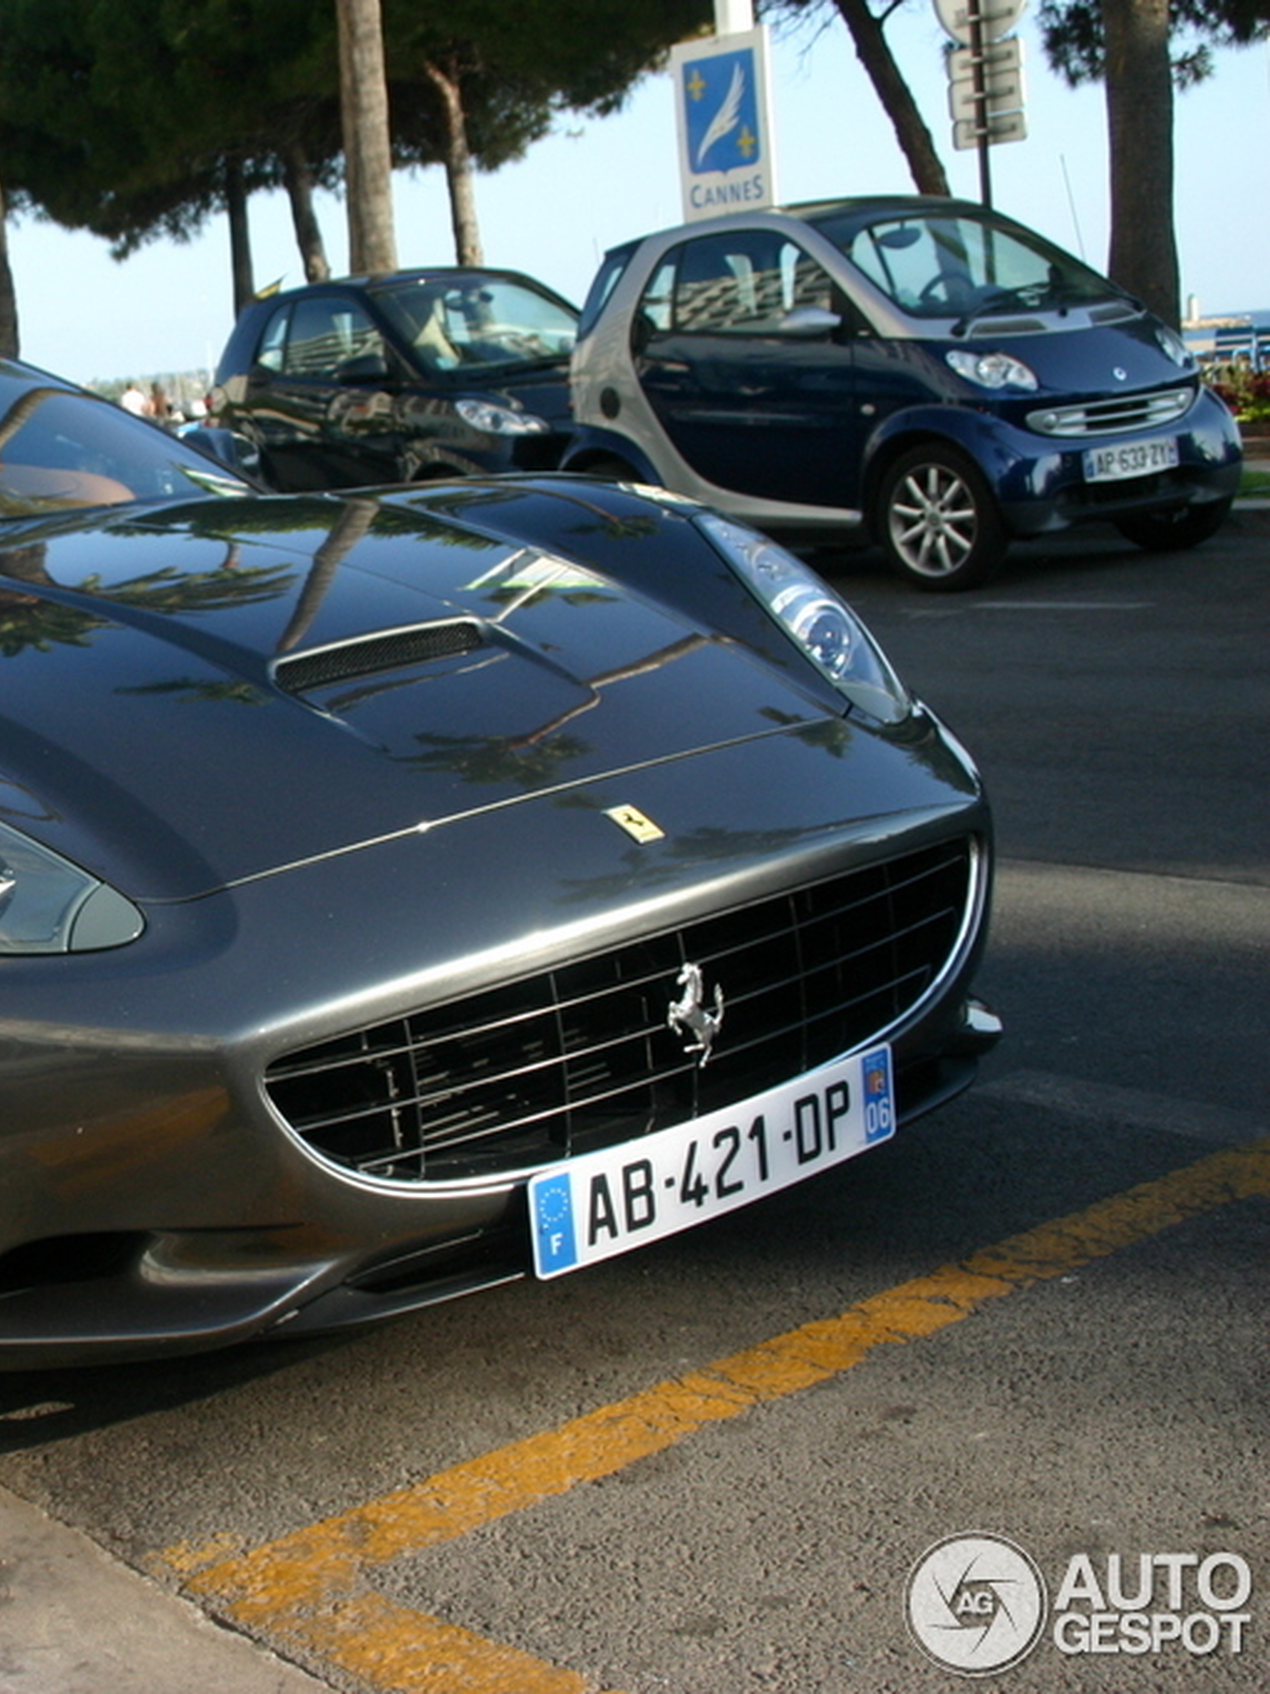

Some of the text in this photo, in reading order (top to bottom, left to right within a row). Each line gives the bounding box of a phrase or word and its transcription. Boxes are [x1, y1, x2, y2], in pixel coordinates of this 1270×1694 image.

[690, 173, 764, 209] CANNES
[866, 1097, 891, 1134] 06
[588, 1080, 850, 1246] AB-421-DP
[550, 1233, 563, 1256] F
